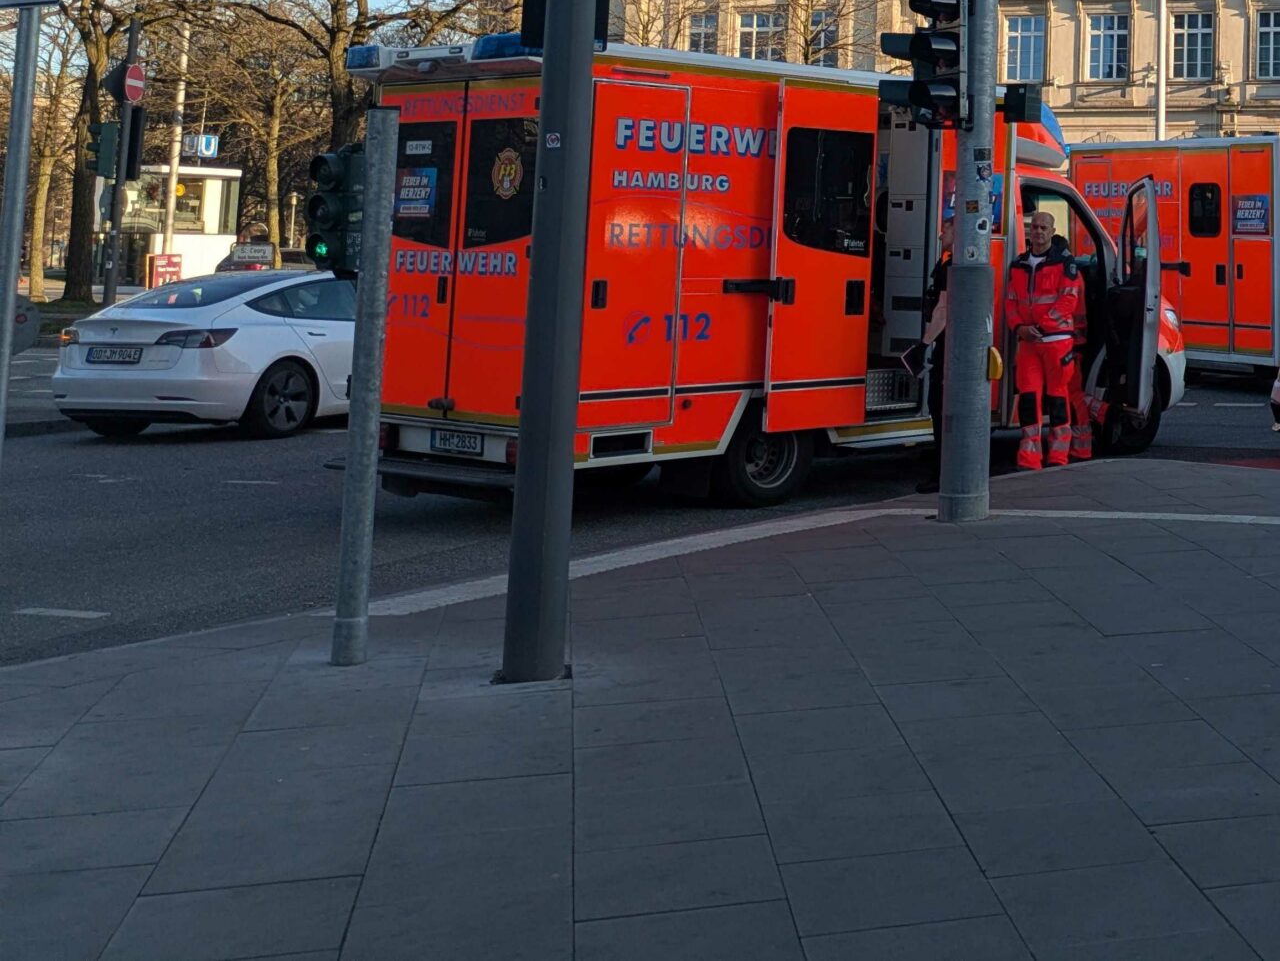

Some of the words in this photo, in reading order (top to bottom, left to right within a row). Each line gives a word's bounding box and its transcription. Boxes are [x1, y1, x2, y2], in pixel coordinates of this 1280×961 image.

[402, 92, 526, 116] RETTUNGSDIENST
[613, 170, 731, 192] HAMBURG
[402, 294, 431, 318] 112
[664, 313, 711, 341] 112
